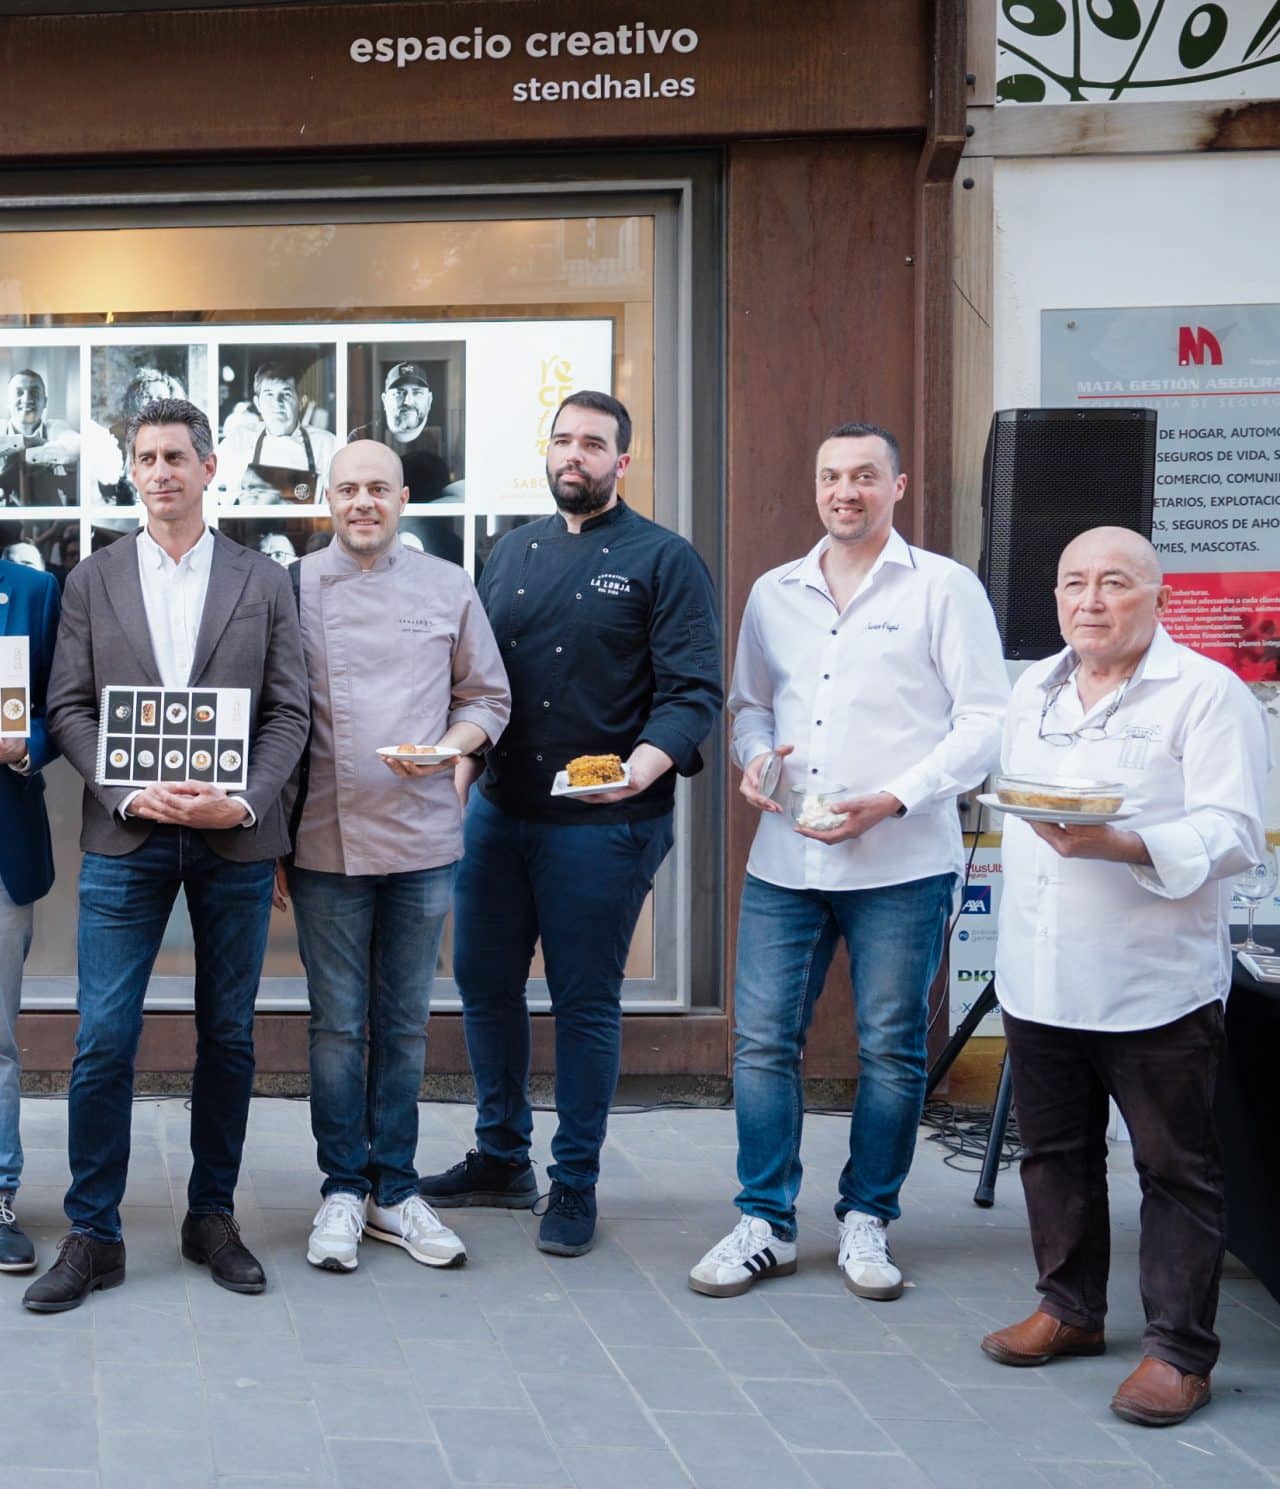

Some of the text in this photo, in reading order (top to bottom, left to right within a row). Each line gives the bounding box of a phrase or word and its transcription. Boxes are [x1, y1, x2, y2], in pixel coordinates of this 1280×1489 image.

[350, 22, 699, 67] espacio creativo
[512, 73, 696, 101] stendhal.es
[1078, 380, 1123, 393] MATA
[1130, 376, 1200, 391] GESTIÓN
[1159, 429, 1176, 440] DE
[1179, 428, 1227, 440] HOGAR,
[1157, 451, 1214, 463] SEGUROS
[1217, 450, 1233, 461] DE
[1237, 450, 1270, 461] VIDA,
[1156, 472, 1280, 485] COMERCIO, COMUNI
[1172, 519, 1229, 530] SEGUROS
[1232, 518, 1248, 529] DE
[1191, 541, 1260, 552] MASCOTAS.
